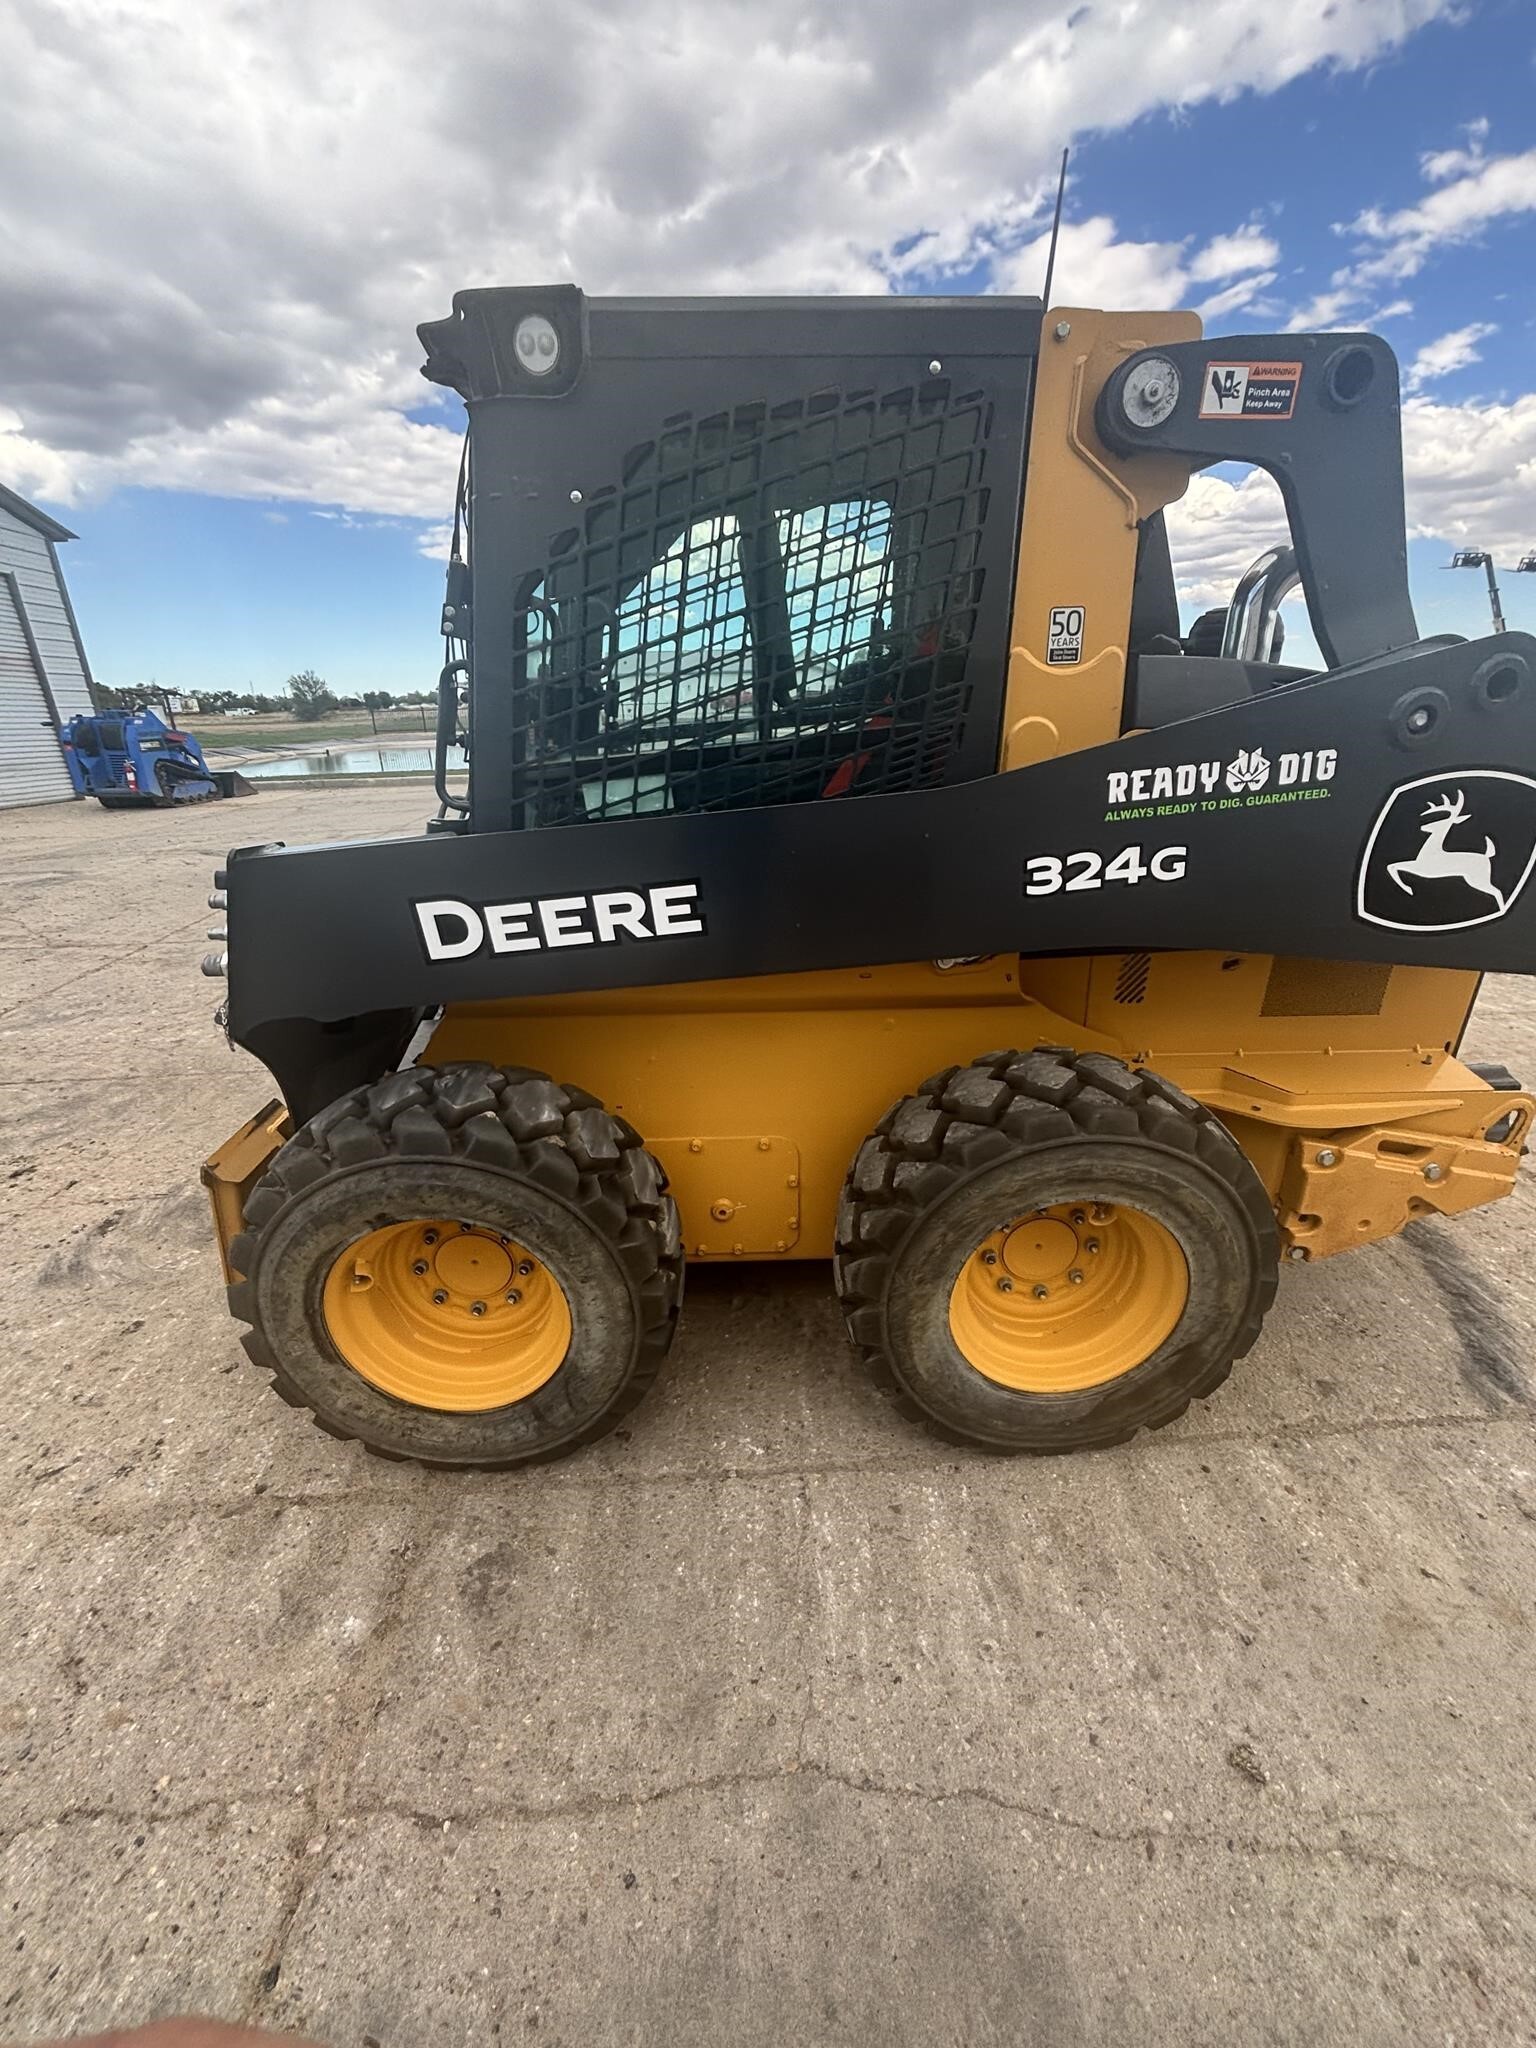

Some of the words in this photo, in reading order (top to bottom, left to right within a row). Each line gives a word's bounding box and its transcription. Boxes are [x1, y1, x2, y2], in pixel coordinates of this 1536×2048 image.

[1259, 367, 1297, 376] WARNING
[1245, 399, 1263, 409] Keep
[1263, 400, 1283, 409] Away
[1248, 387, 1270, 397] Pinch
[1271, 387, 1291, 397] Area
[1051, 610, 1082, 637] 50
[1050, 637, 1080, 647] YEARS
[1107, 761, 1221, 804] READY
[1278, 749, 1338, 785] DIG
[1104, 807, 1154, 822] ALWAYS
[1157, 802, 1197, 816] READY
[1200, 800, 1217, 811] TO
[1220, 797, 1243, 809] DIG.
[1246, 788, 1332, 806] GUARANTEED.
[1025, 846, 1188, 896] 324G
[415, 884, 703, 961] DEERE
